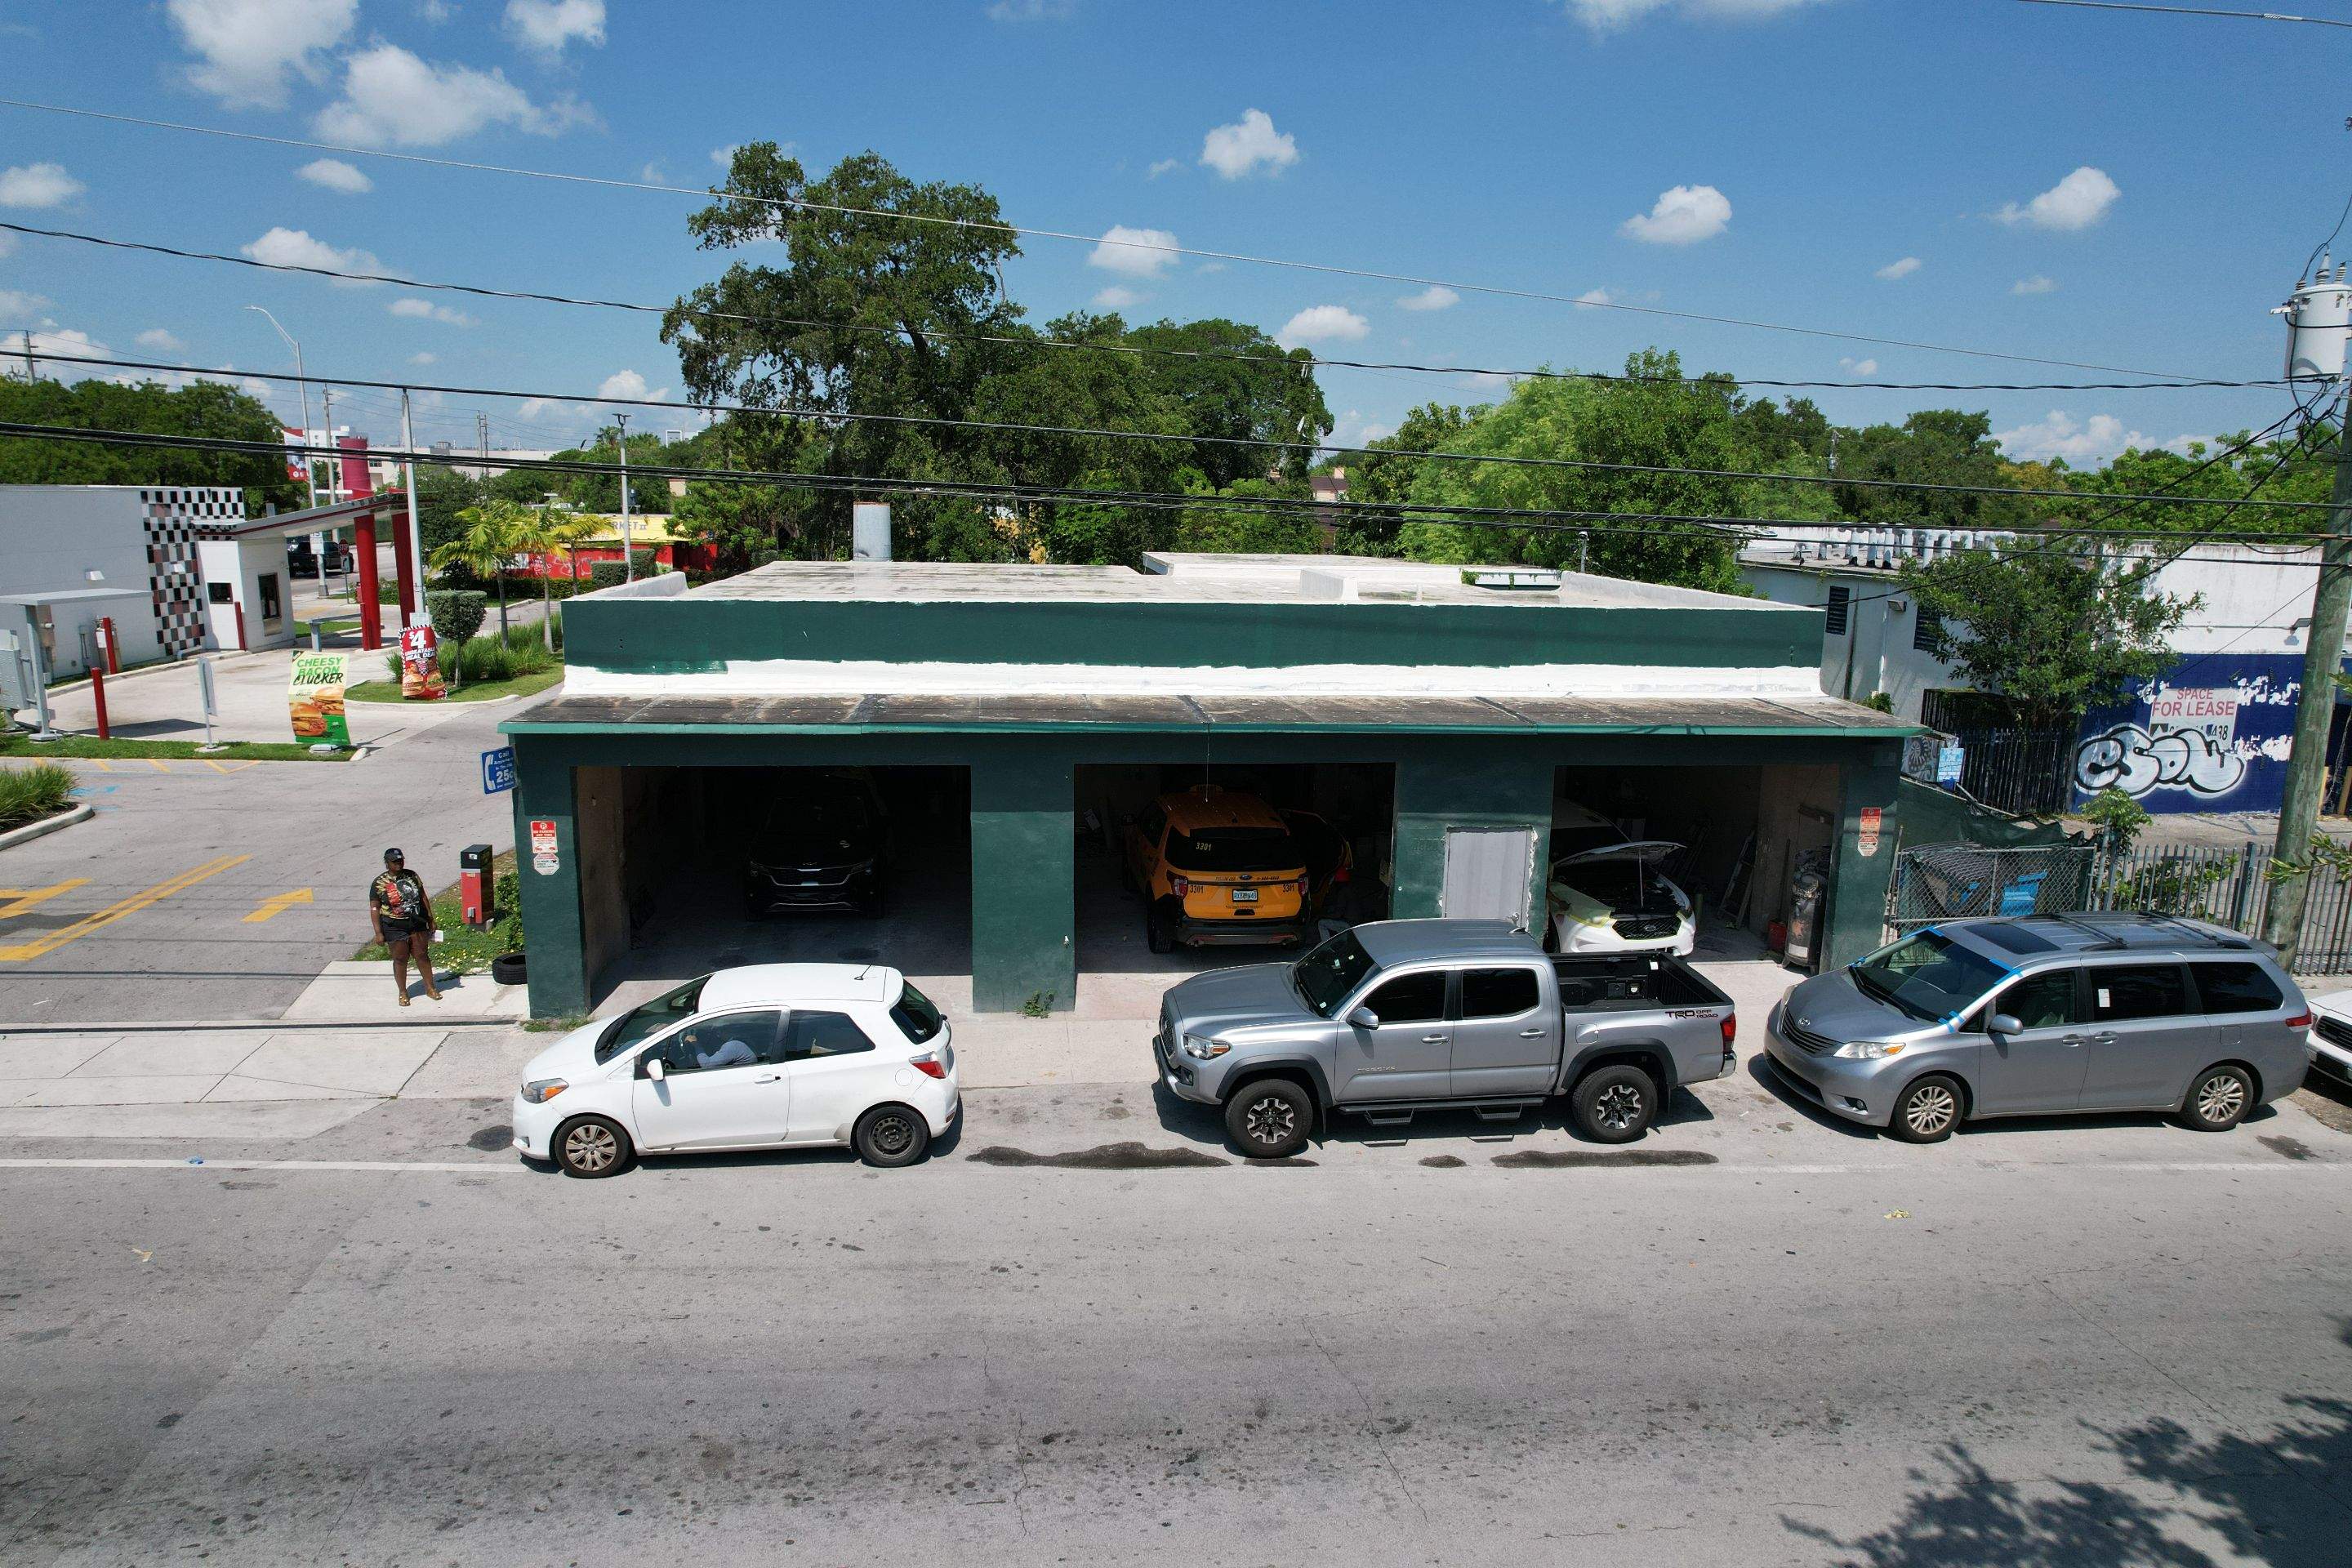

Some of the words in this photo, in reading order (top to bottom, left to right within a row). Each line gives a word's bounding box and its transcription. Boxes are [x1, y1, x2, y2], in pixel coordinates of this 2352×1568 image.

[339, 543, 349, 551] STOP
[409, 630, 427, 649] $4
[297, 657, 343, 667] CHEESY
[298, 666, 340, 676] BACON
[293, 672, 344, 685] CLUCKER
[2176, 688, 2214, 700] SPACE
[2152, 702, 2182, 716] FOR
[2186, 701, 2235, 716] LEASE
[1196, 842, 1212, 851] 3301
[1190, 885, 1204, 893] 3301
[1282, 884, 1295, 893] 3301
[1664, 1009, 1695, 1019] TRD
